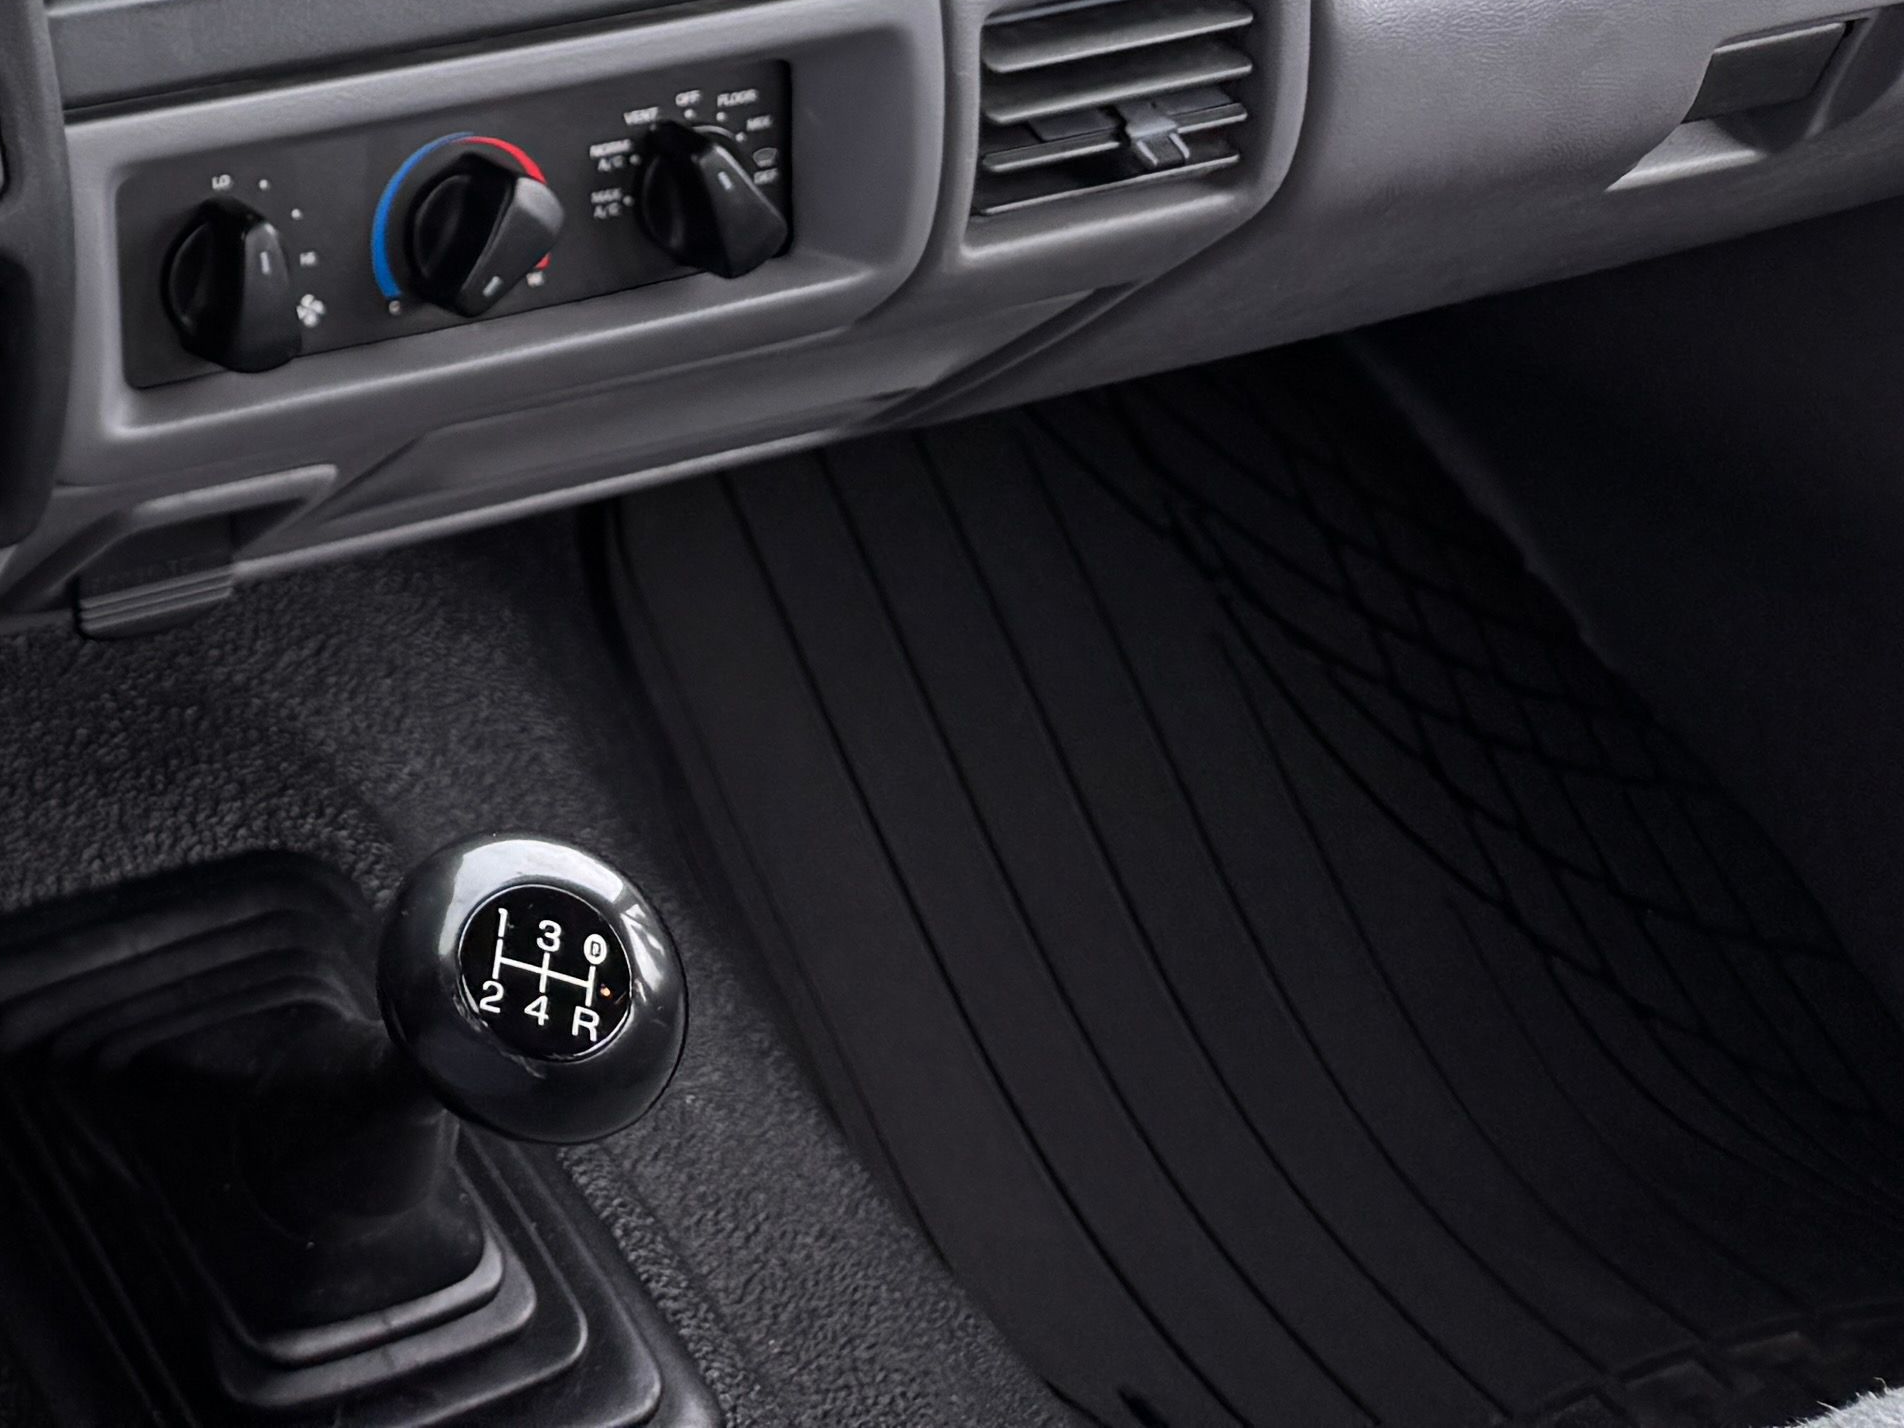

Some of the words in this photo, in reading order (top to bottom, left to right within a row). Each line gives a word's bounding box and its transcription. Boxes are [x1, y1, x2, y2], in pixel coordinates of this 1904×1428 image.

[212, 174, 232, 190] LO
[498, 907, 508, 938] 1
[536, 920, 562, 952] 3
[479, 980, 505, 1013] 2
[524, 995, 550, 1027] 4
[571, 1006, 601, 1042] R
